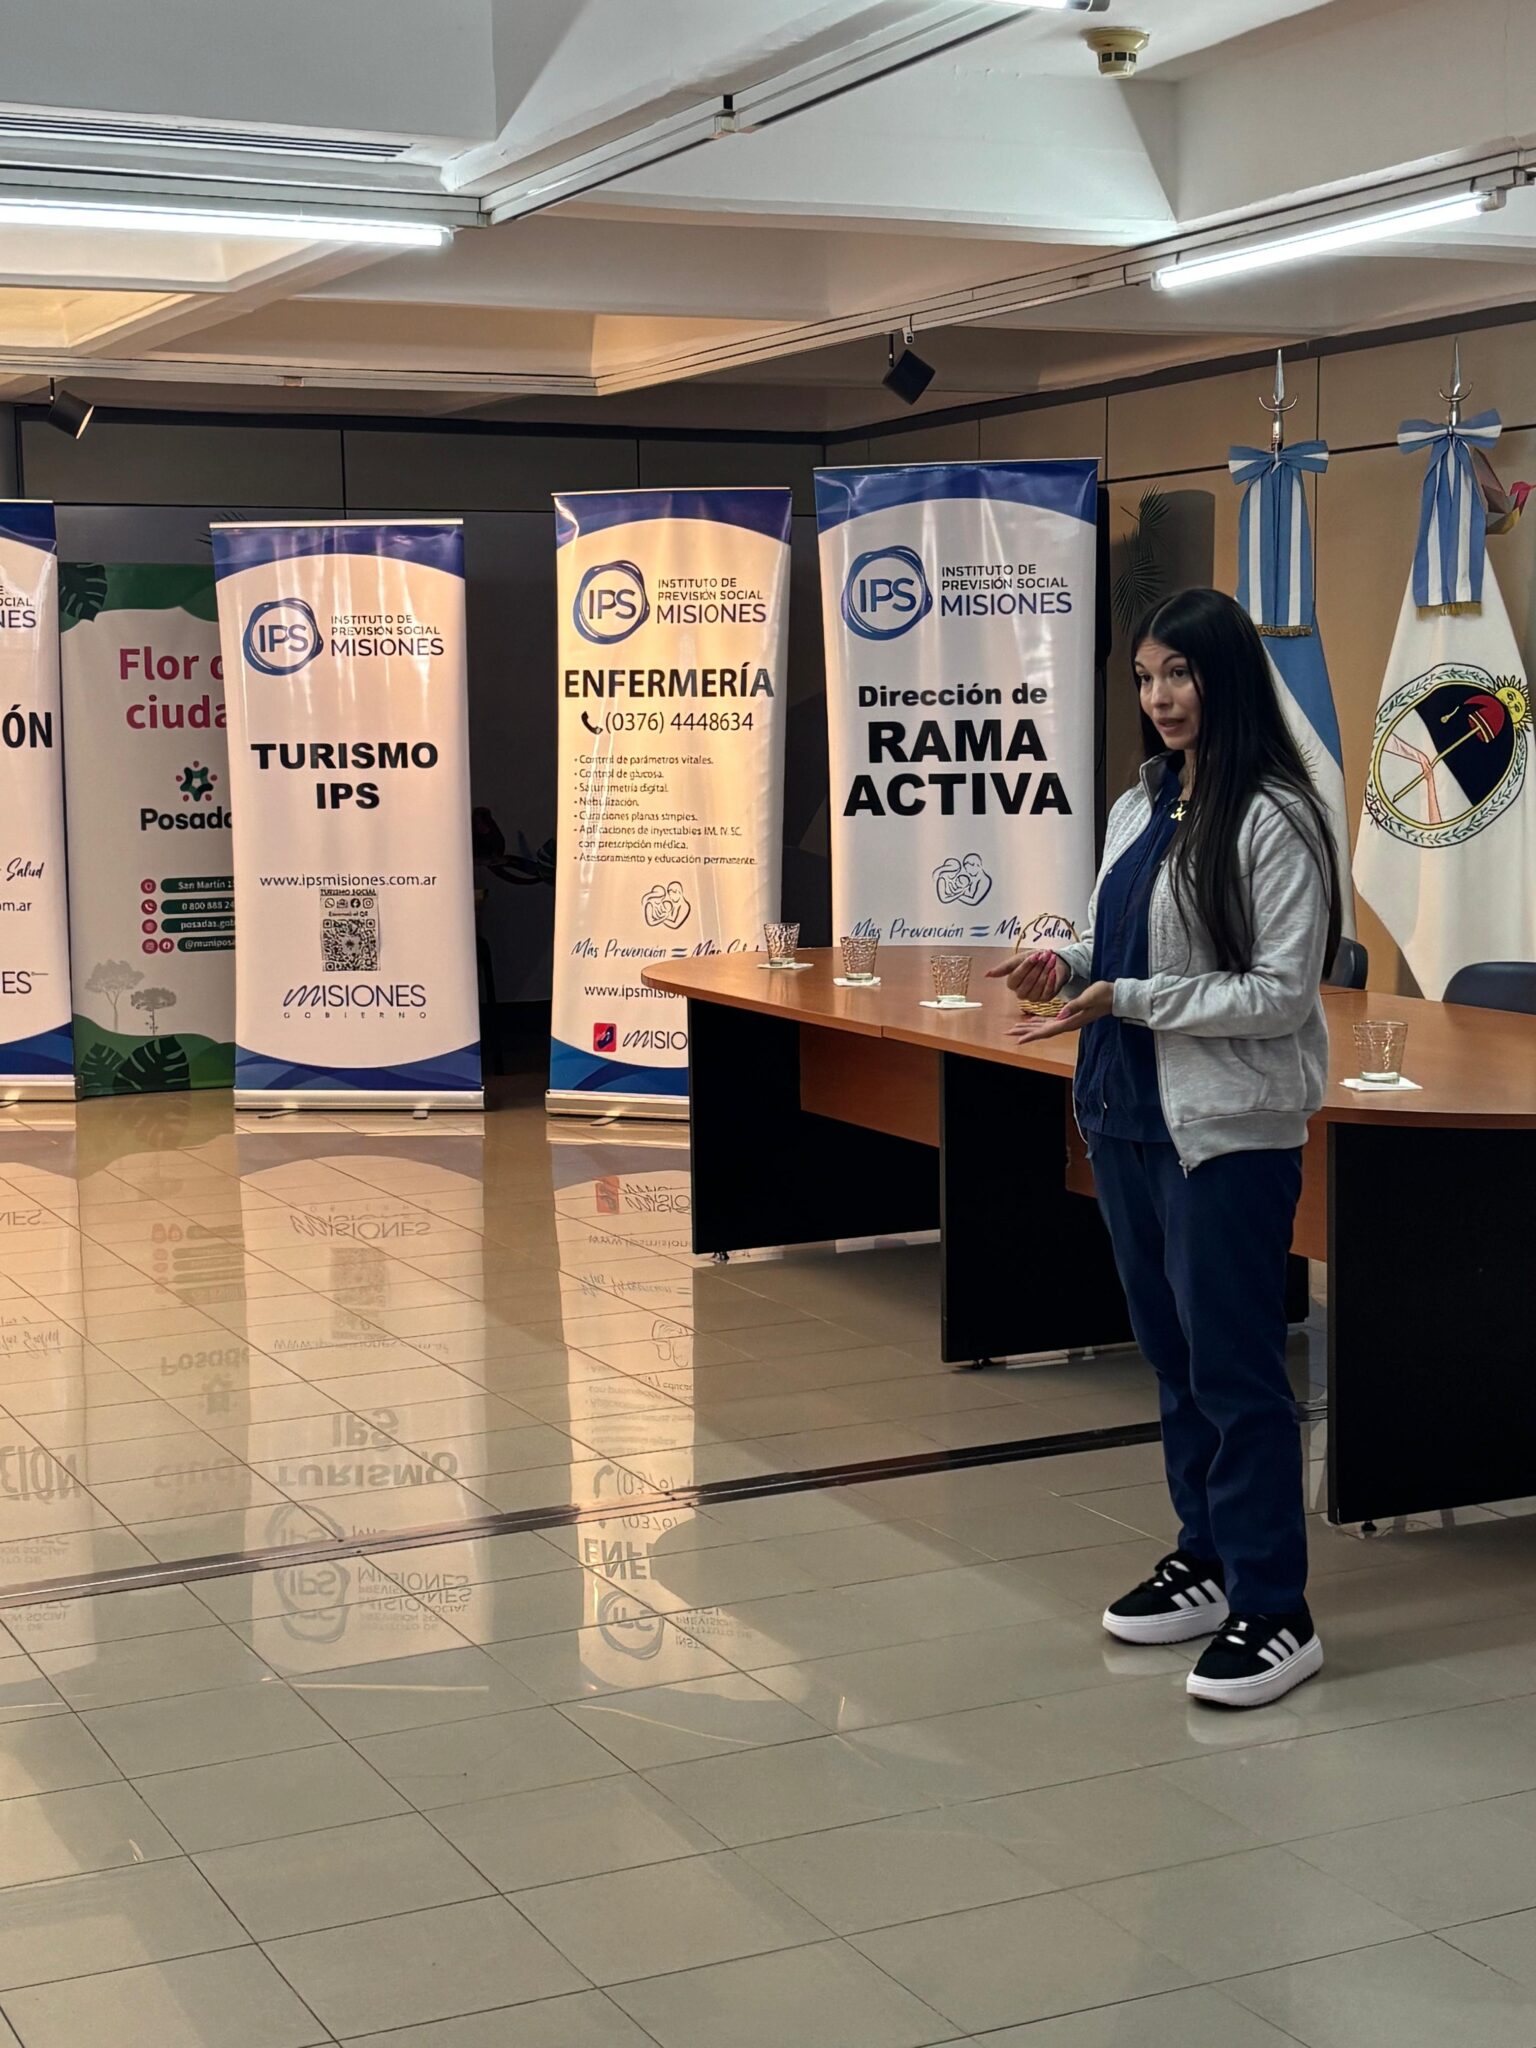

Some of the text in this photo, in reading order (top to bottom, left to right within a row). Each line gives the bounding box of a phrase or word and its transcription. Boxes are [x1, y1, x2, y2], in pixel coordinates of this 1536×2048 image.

[942, 564, 1036, 577] INSTITUTO DE
[658, 578, 737, 589] INSTITUTO DE
[942, 577, 1068, 591] PREVISIÓN SOCIAL
[588, 589, 637, 620] IPS
[657, 589, 763, 601] PREVISIÓN SOCIAL
[859, 578, 916, 613] IPS
[941, 592, 1072, 616] MISIONES
[331, 615, 413, 625] INSTITUTO DE
[656, 603, 767, 624] MISIONES
[258, 624, 309, 653] IPS
[331, 624, 440, 636] PREVISIÓN SOCIAL
[331, 638, 444, 657] MISIONES
[120, 646, 199, 681] Flor
[564, 661, 775, 698] ENFERMERÍA
[859, 683, 1047, 708] Dirección de
[605, 711, 754, 733] (0376) 4448634
[868, 719, 1048, 763] RAMA
[250, 742, 438, 769] TURISMO
[616, 755, 628, 765] de
[630, 755, 679, 767] parámetros
[681, 755, 714, 765] vitales.
[616, 769, 628, 779] de
[316, 783, 380, 809] IPS
[843, 772, 1073, 817] ACTIVA
[631, 811, 659, 822] planas
[637, 826, 649, 836] de
[6, 857, 45, 881] Salud
[259, 873, 438, 889] www.ipsmisiones.com.ar
[851, 917, 881, 940] Más
[889, 917, 964, 940] Prevención
[994, 915, 1026, 940] Más
[1033, 915, 1075, 943] Salud
[571, 938, 599, 958] Más
[604, 938, 667, 958] Prevención
[283, 984, 427, 1007] MISIONES
